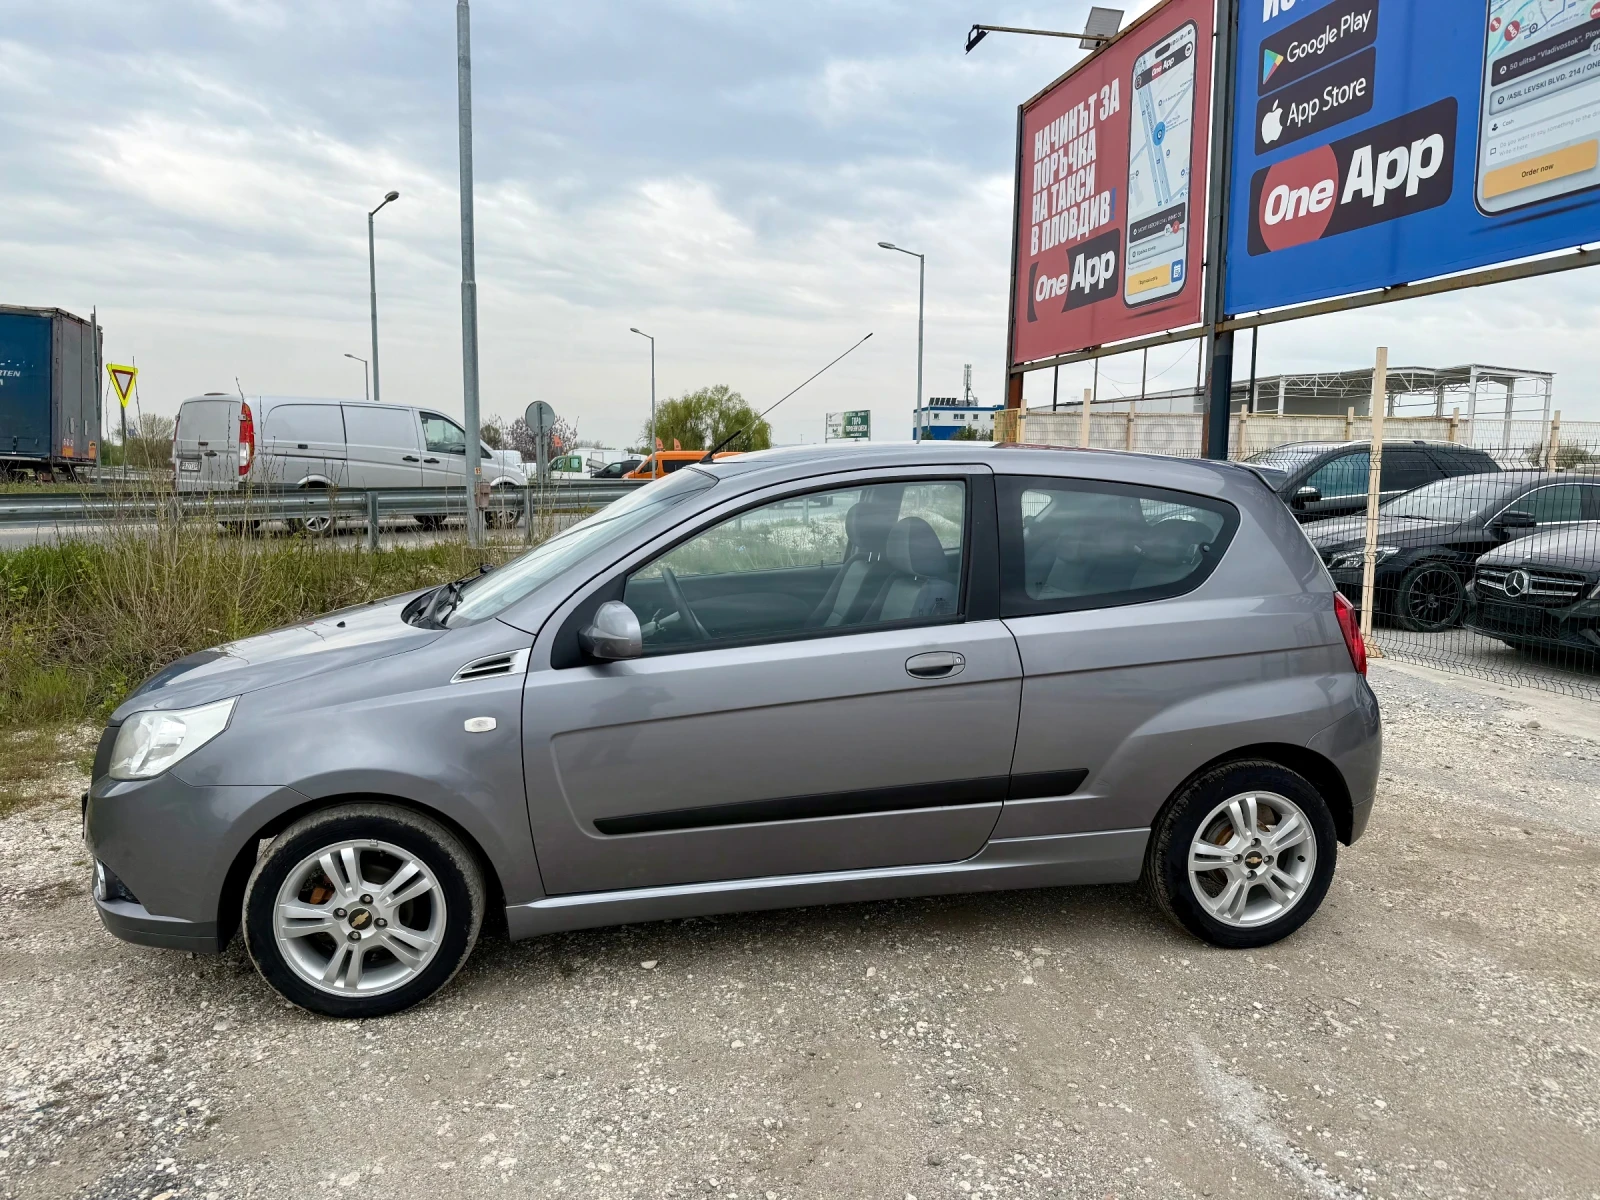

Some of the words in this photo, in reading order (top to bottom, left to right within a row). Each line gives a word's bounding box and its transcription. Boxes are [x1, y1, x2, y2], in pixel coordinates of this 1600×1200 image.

[1287, 25, 1338, 63] Google
[1340, 9, 1372, 38] Play
[1151, 65, 1162, 76] One
[1162, 57, 1175, 70] App
[1509, 61, 1518, 70] 50
[1518, 55, 1536, 67] ulitsa
[1523, 81, 1547, 94] LEVSKI
[1548, 74, 1567, 85] BLVD.
[1569, 67, 1581, 77] 214
[1034, 92, 1098, 163] НАЧИНЪТ
[1099, 77, 1120, 121] ЗА
[1287, 98, 1319, 127] App
[1322, 77, 1366, 111] Store
[1033, 128, 1097, 194] ПОРЪЧКА
[1264, 178, 1335, 225] One
[1340, 133, 1444, 207] App
[1521, 166, 1539, 178] Order
[1540, 163, 1554, 172] now
[1032, 189, 1048, 225] НА
[1051, 163, 1096, 215] ТАКСИ
[1030, 225, 1039, 256] В
[1035, 273, 1068, 302] One
[1070, 250, 1116, 294] App
